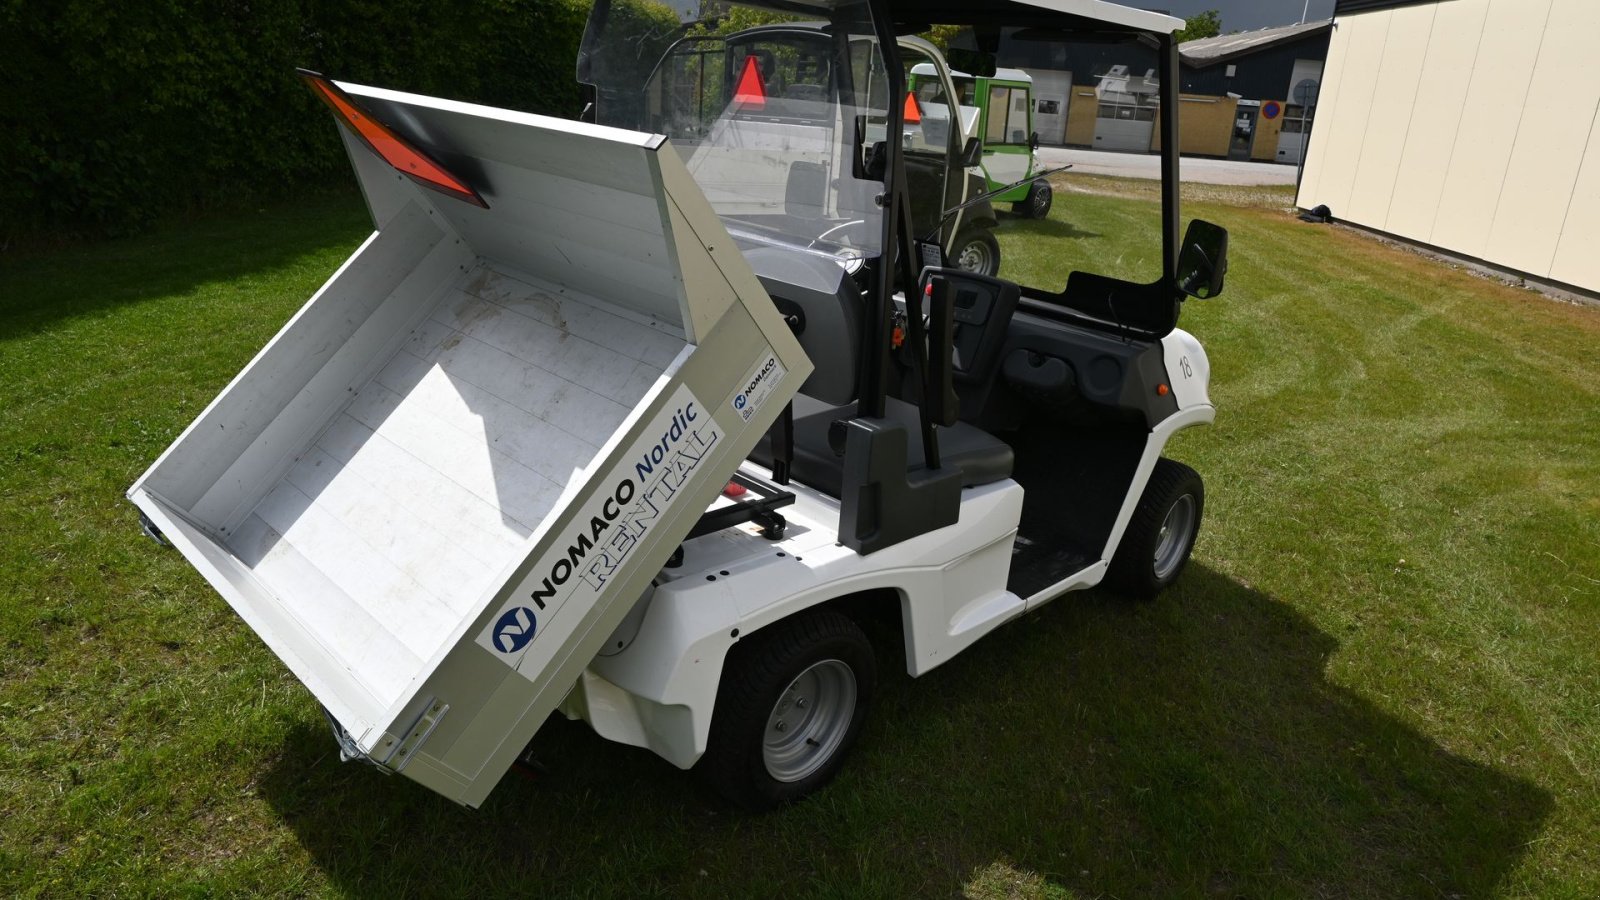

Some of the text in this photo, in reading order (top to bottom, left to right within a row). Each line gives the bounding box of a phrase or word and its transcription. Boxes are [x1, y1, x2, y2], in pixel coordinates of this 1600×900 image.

[745, 358, 775, 397] NOMACO
[1180, 355, 1192, 380] 18
[531, 478, 635, 610] NOMACO
[635, 402, 698, 483] Nordic
[579, 420, 717, 592] RENTAL
